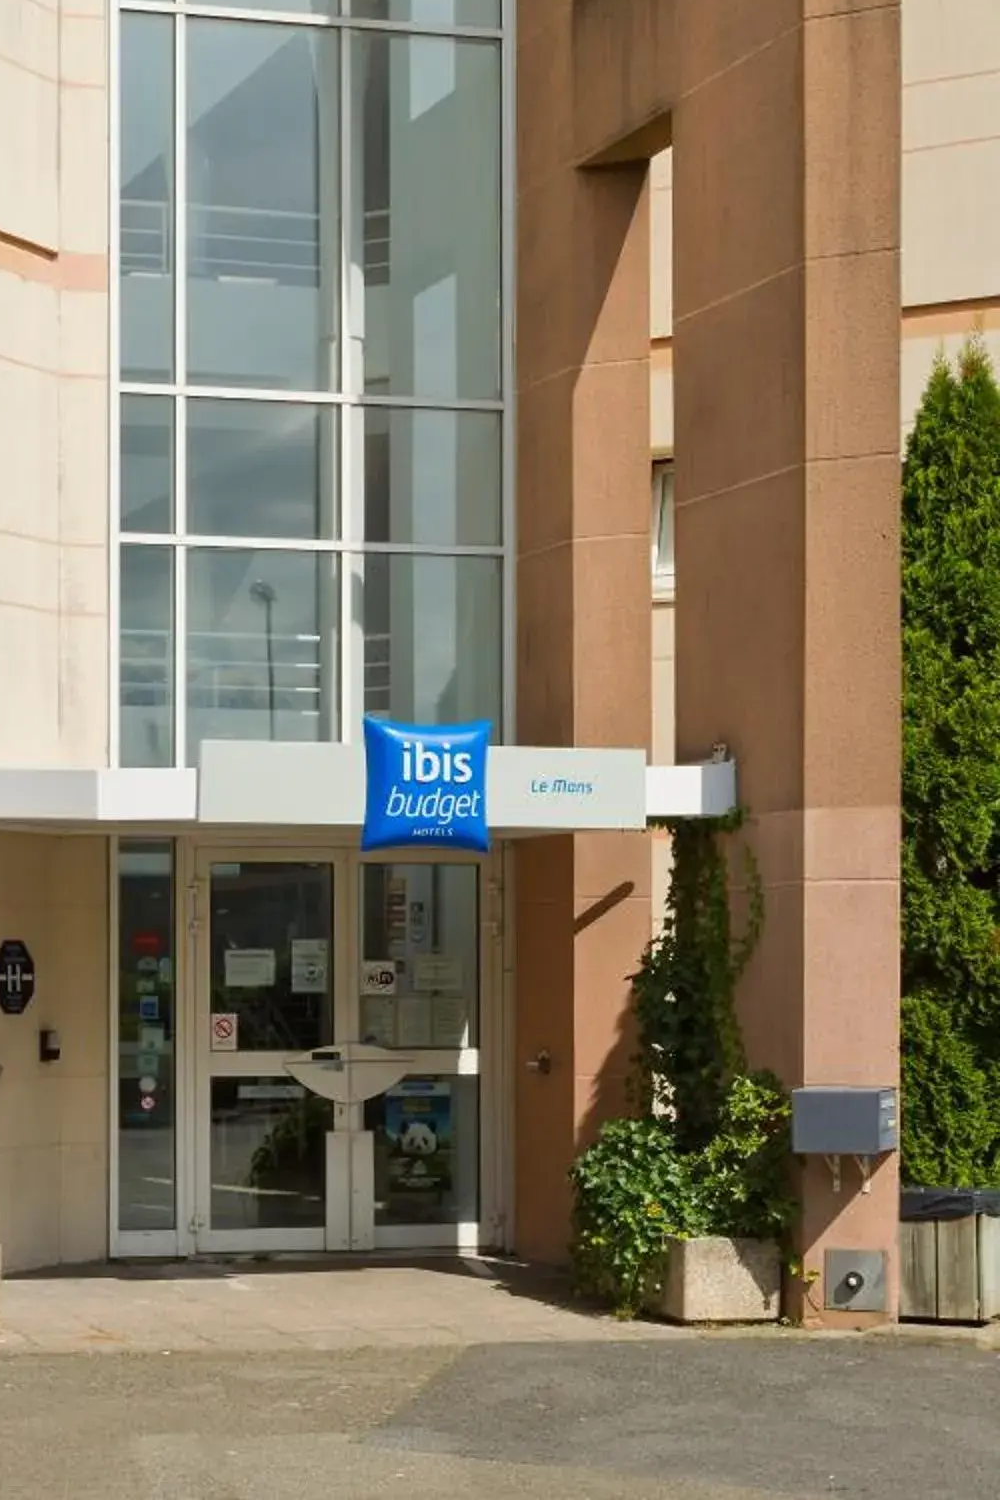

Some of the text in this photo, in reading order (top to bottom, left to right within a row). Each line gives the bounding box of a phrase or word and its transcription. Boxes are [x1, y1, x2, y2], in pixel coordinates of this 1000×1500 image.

[402, 740, 473, 783] ibis
[531, 779, 593, 794] Le Mans
[385, 785, 481, 825] budget
[411, 826, 455, 837] HOTELS
